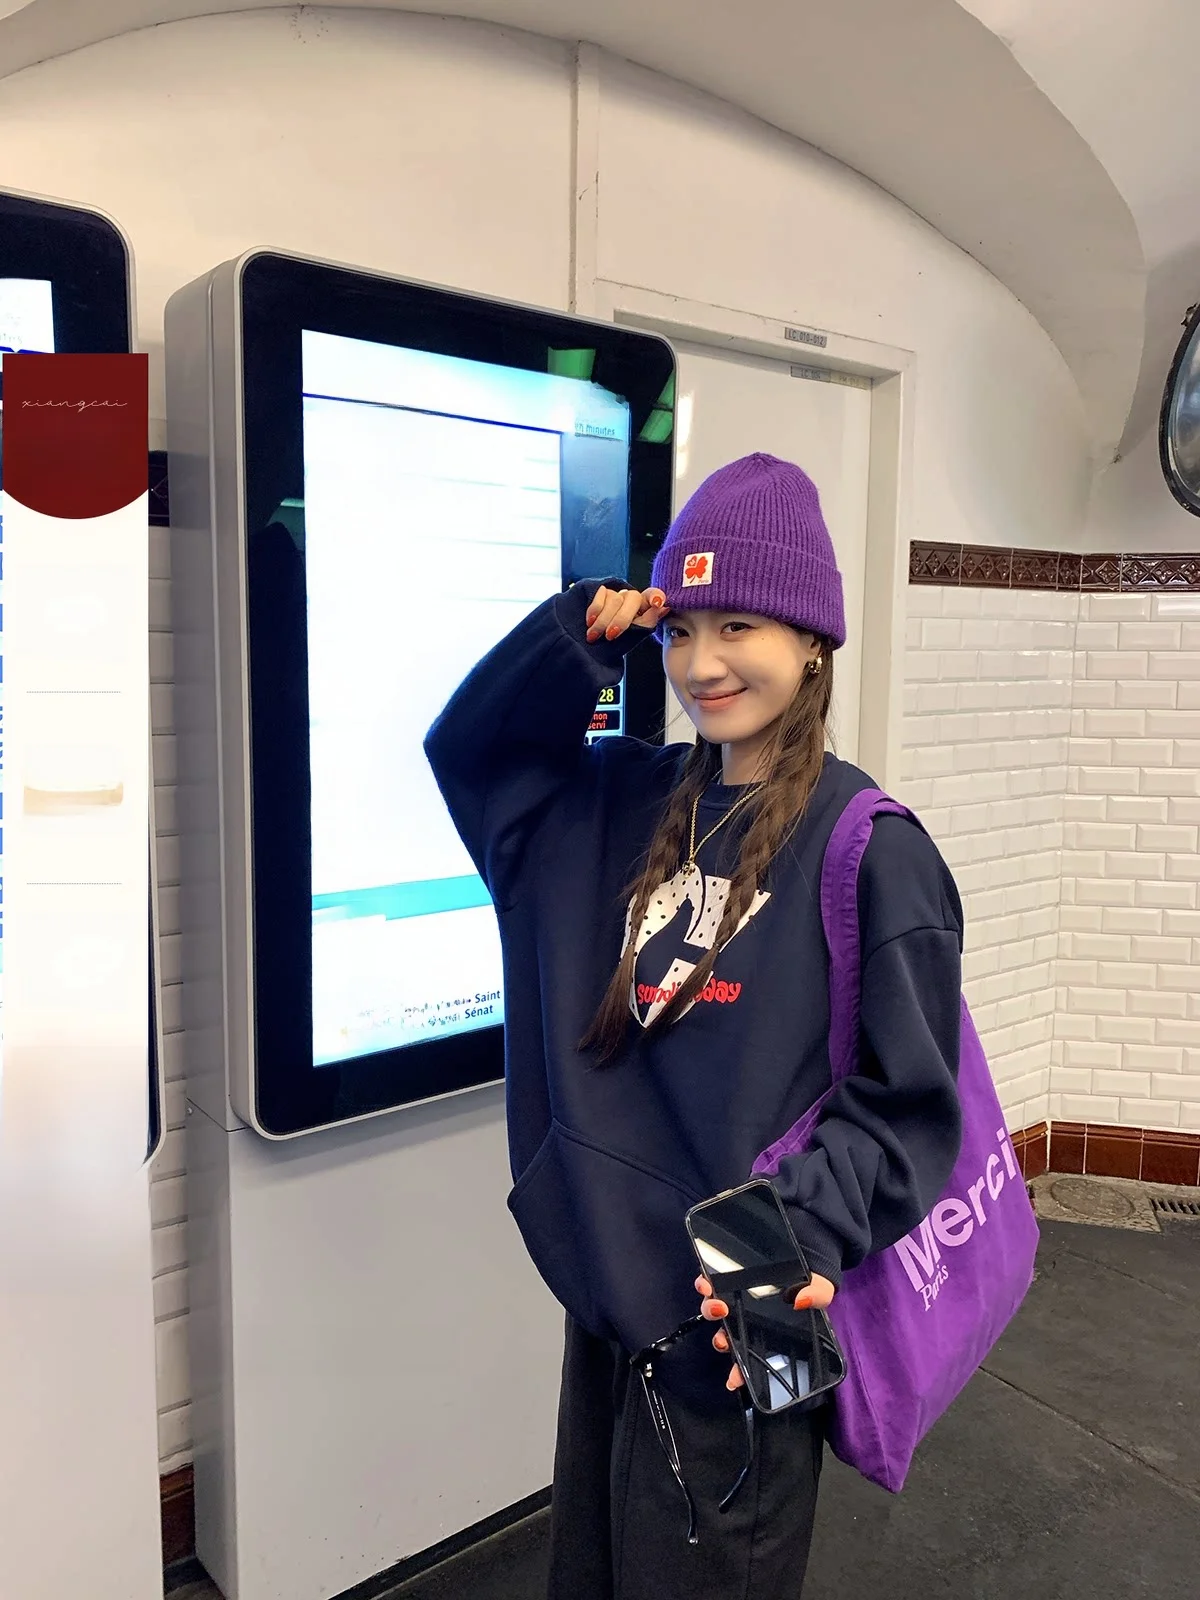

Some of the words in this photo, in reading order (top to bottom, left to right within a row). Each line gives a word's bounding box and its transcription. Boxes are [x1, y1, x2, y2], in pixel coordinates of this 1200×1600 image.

[586, 424, 615, 436] minutes
[599, 688, 614, 703] 28
[593, 712, 608, 720] non
[474, 990, 501, 1004] Saint
[464, 1004, 494, 1019] Sénat
[893, 1127, 1018, 1293] Merci
[920, 1263, 950, 1312] Paris
